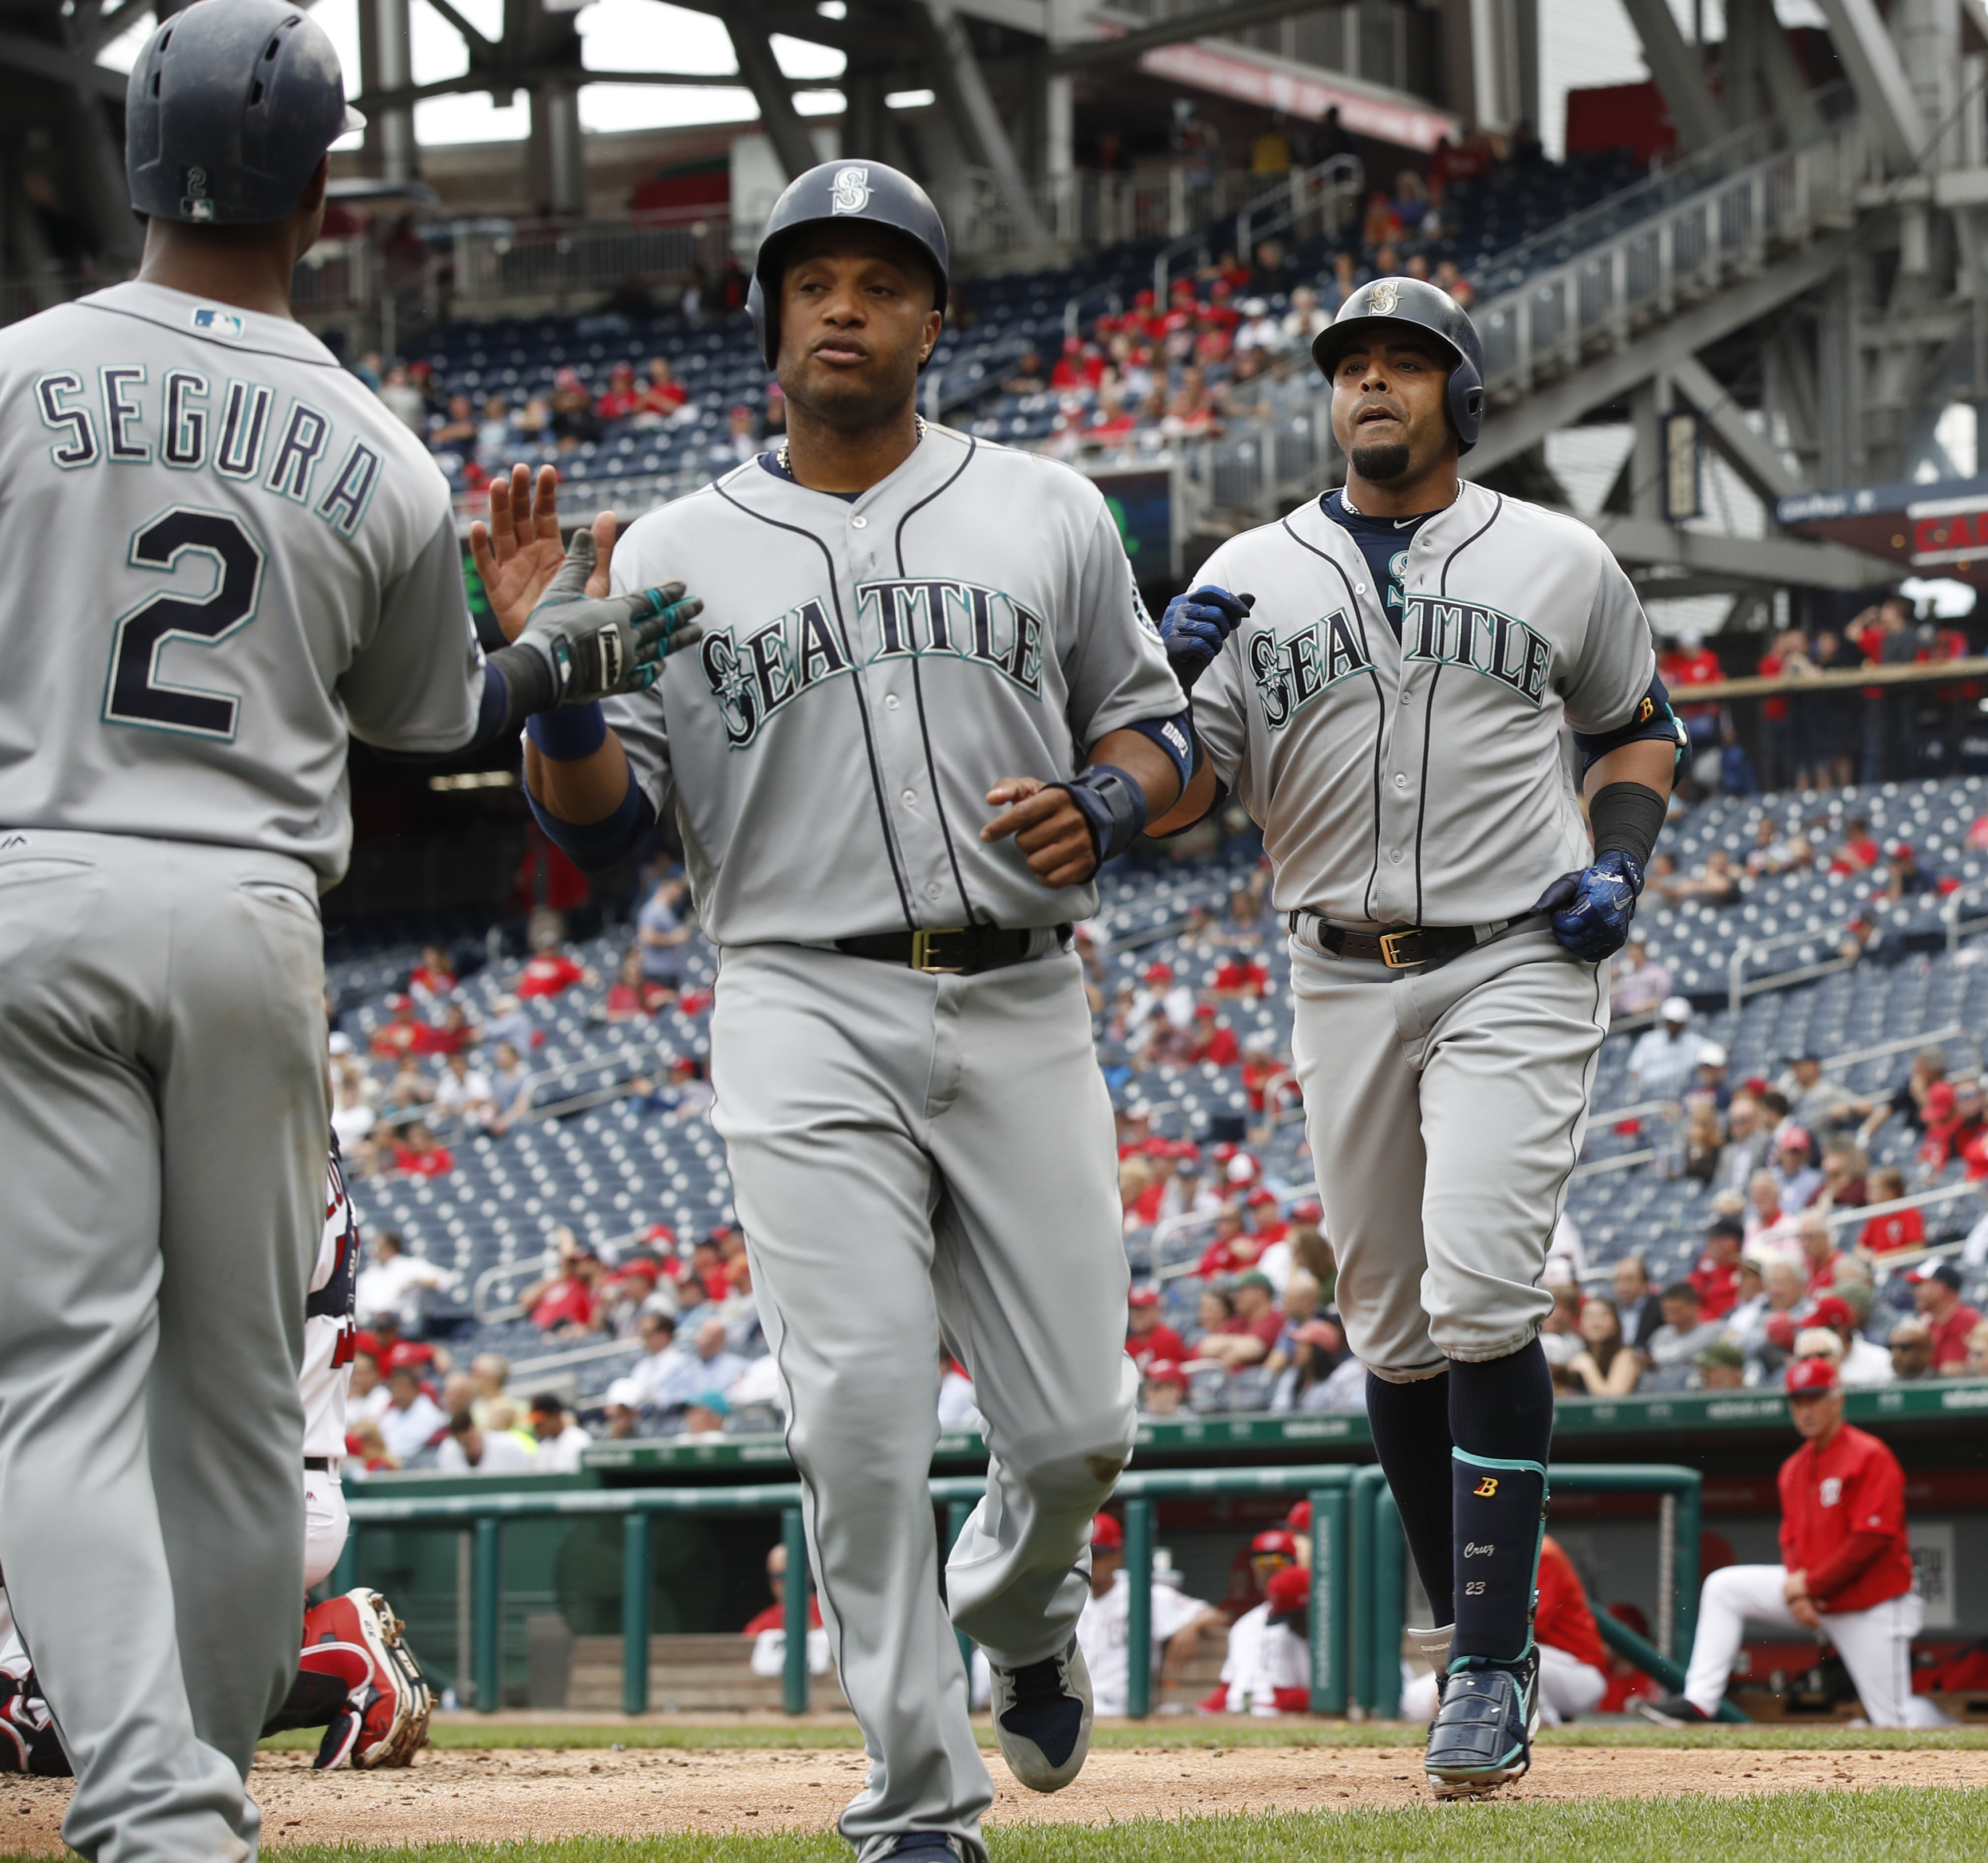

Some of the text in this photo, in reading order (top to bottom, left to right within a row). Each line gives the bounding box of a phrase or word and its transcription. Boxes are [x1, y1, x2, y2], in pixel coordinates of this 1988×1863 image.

[33, 364, 385, 541] SEGURA
[101, 502, 267, 743] 2
[699, 577, 1044, 752] SEATTLE
[1247, 593, 1552, 732] SEATTLE
[1463, 1542, 1495, 1558] Cruz
[1473, 1477, 1499, 1497] B
[1465, 1581, 1486, 1596] 23
